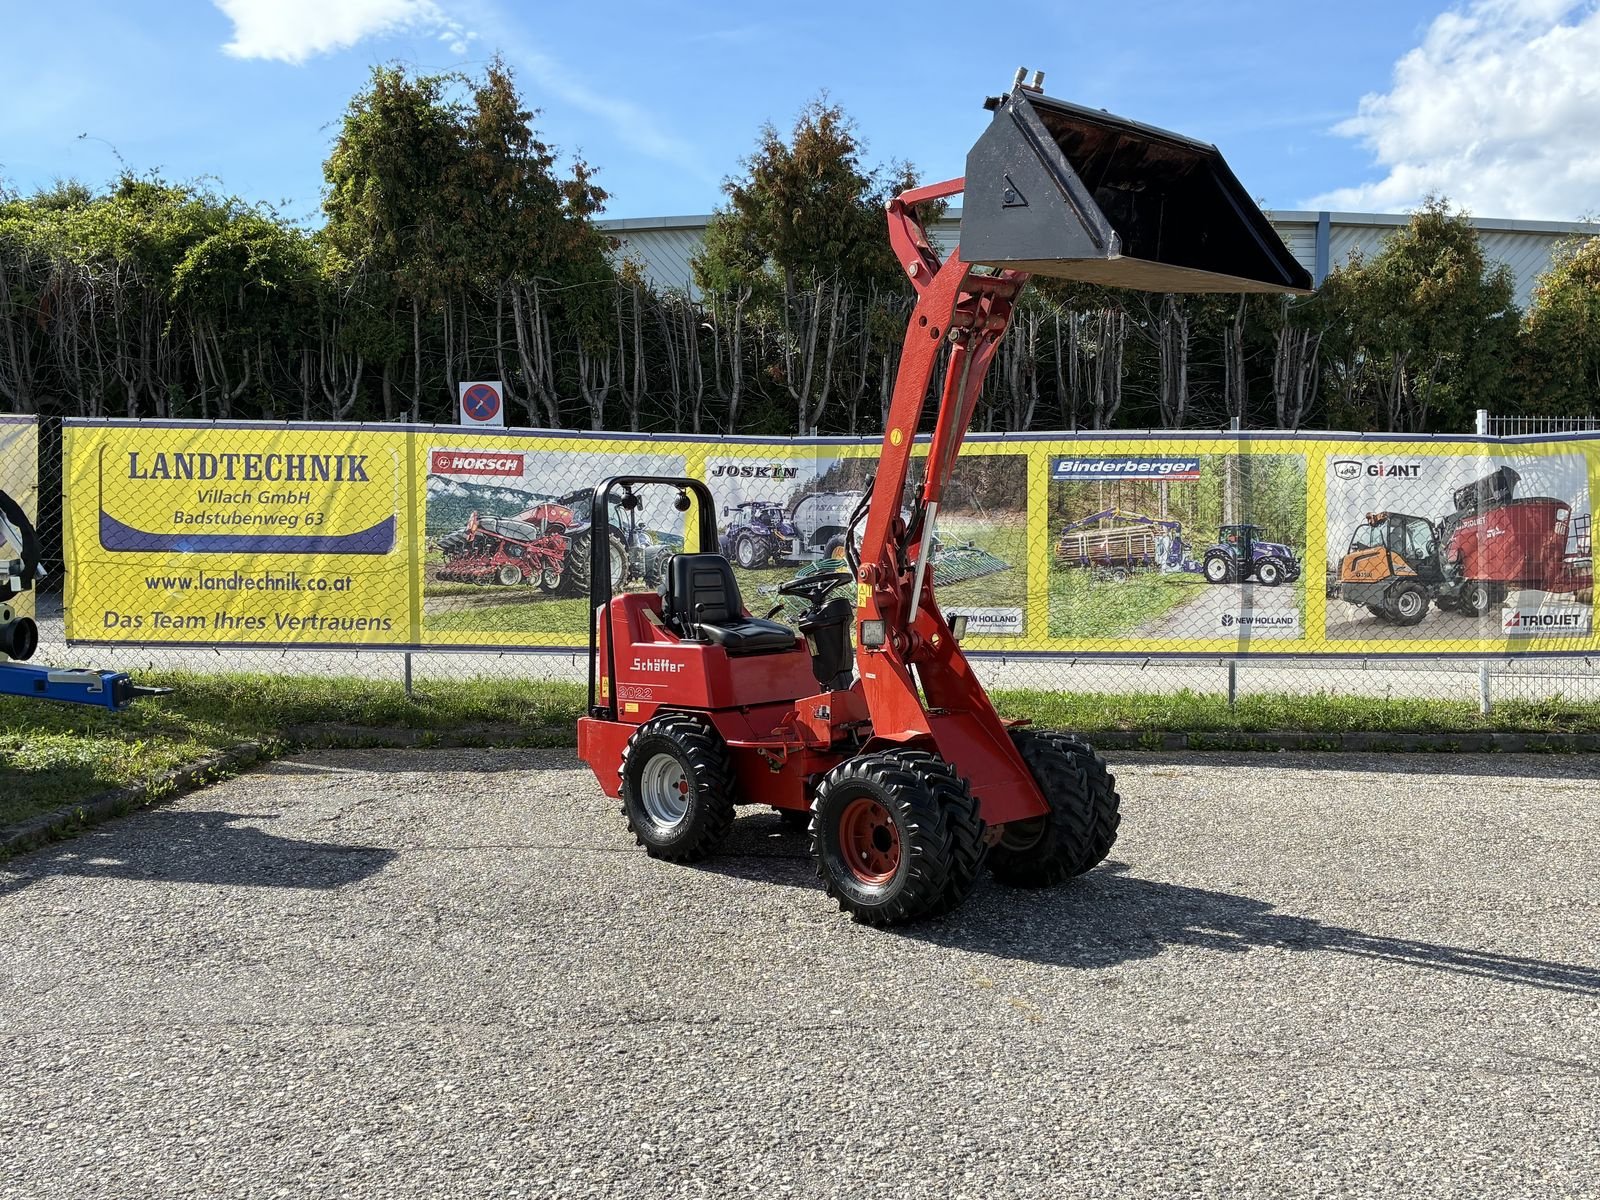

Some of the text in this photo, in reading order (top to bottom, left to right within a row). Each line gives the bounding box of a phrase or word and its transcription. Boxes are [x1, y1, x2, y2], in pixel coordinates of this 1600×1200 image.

[128, 452, 370, 482] LANDTECHNIK
[452, 457, 518, 470] HORSCH
[1058, 461, 1196, 474] Binderberger
[712, 465, 798, 479] JOSKIN
[197, 490, 311, 505] Villach GmbH
[173, 511, 325, 529] Badstubenweg 63
[145, 571, 352, 592] www.landtechnik.co.at
[103, 611, 392, 631] Das Team Ihres Vertrauens
[982, 615, 1017, 623] HOLLAND
[1235, 617, 1293, 625] NEW HOLLAND
[1521, 614, 1580, 627] TRIOLIET
[630, 658, 685, 673] Schäffer
[618, 685, 653, 700] 2022
